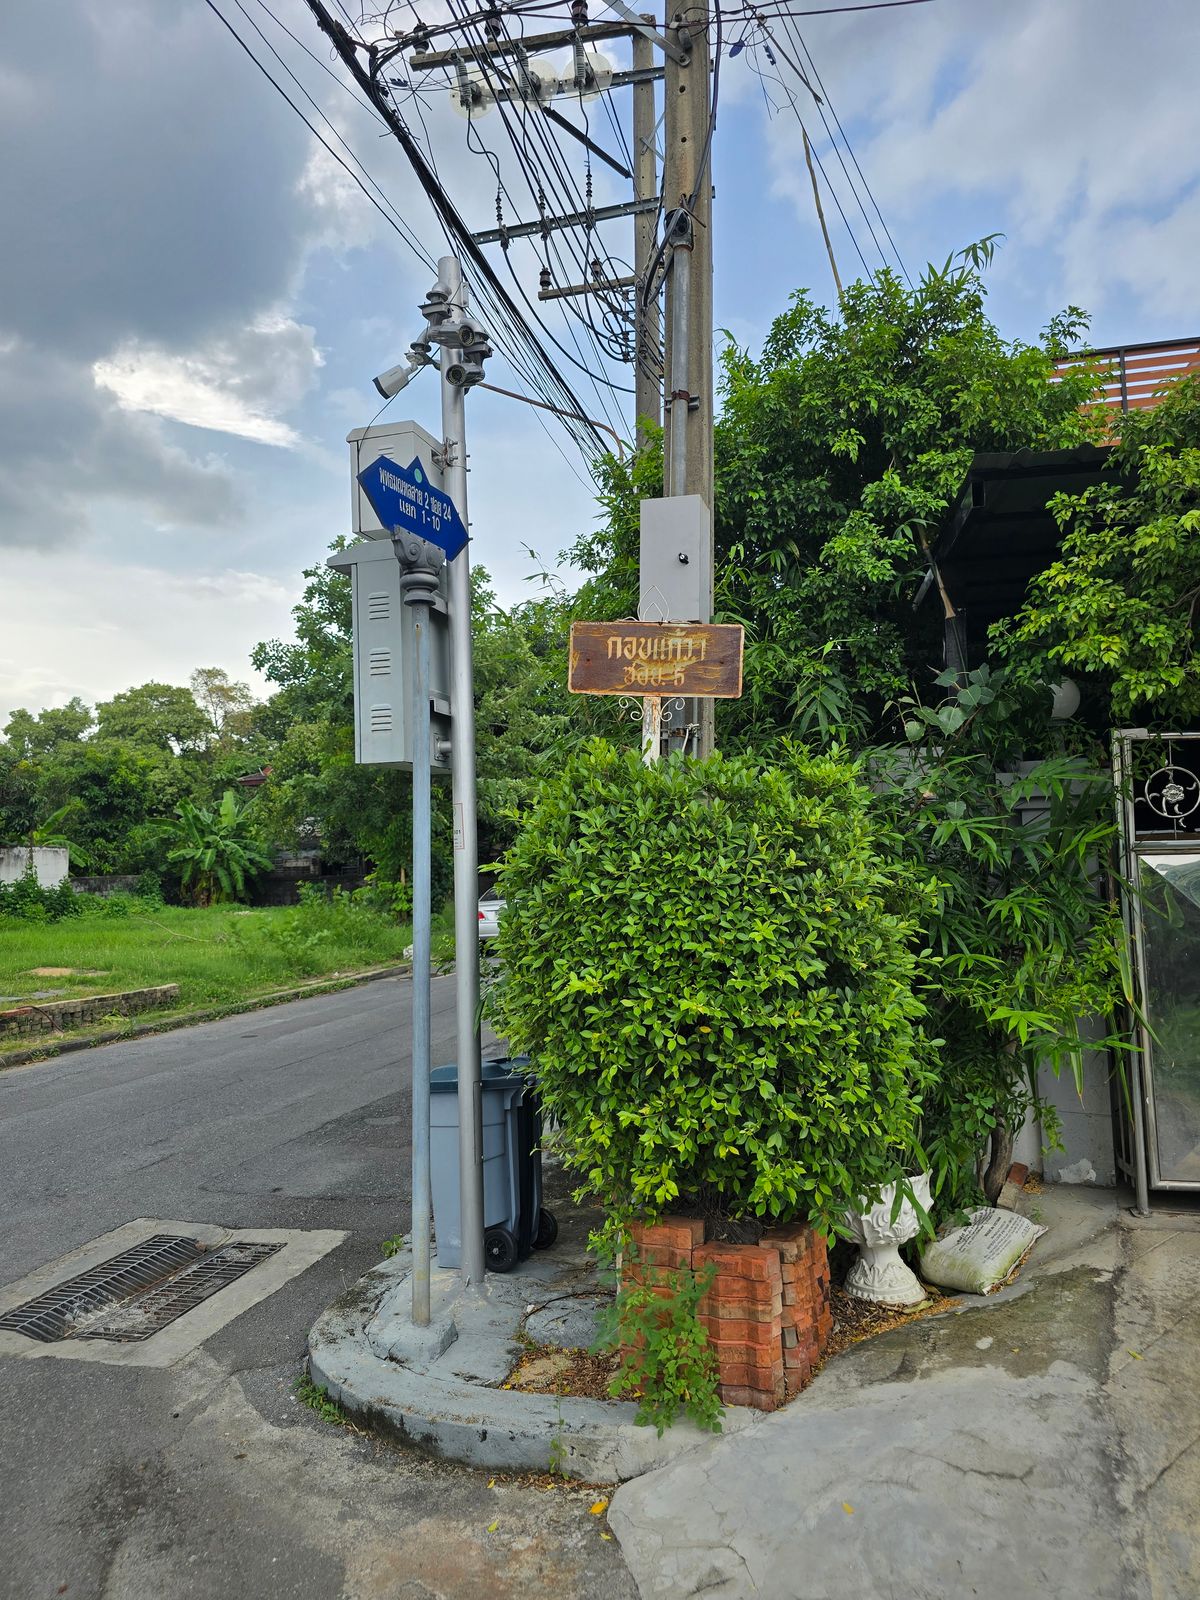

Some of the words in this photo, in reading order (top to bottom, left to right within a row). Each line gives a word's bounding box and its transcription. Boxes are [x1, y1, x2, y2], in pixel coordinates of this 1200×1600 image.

[399, 499, 417, 519] แยก
[424, 492, 430, 510] 2
[430, 496, 442, 516] ซอย
[443, 503, 452, 522] 24
